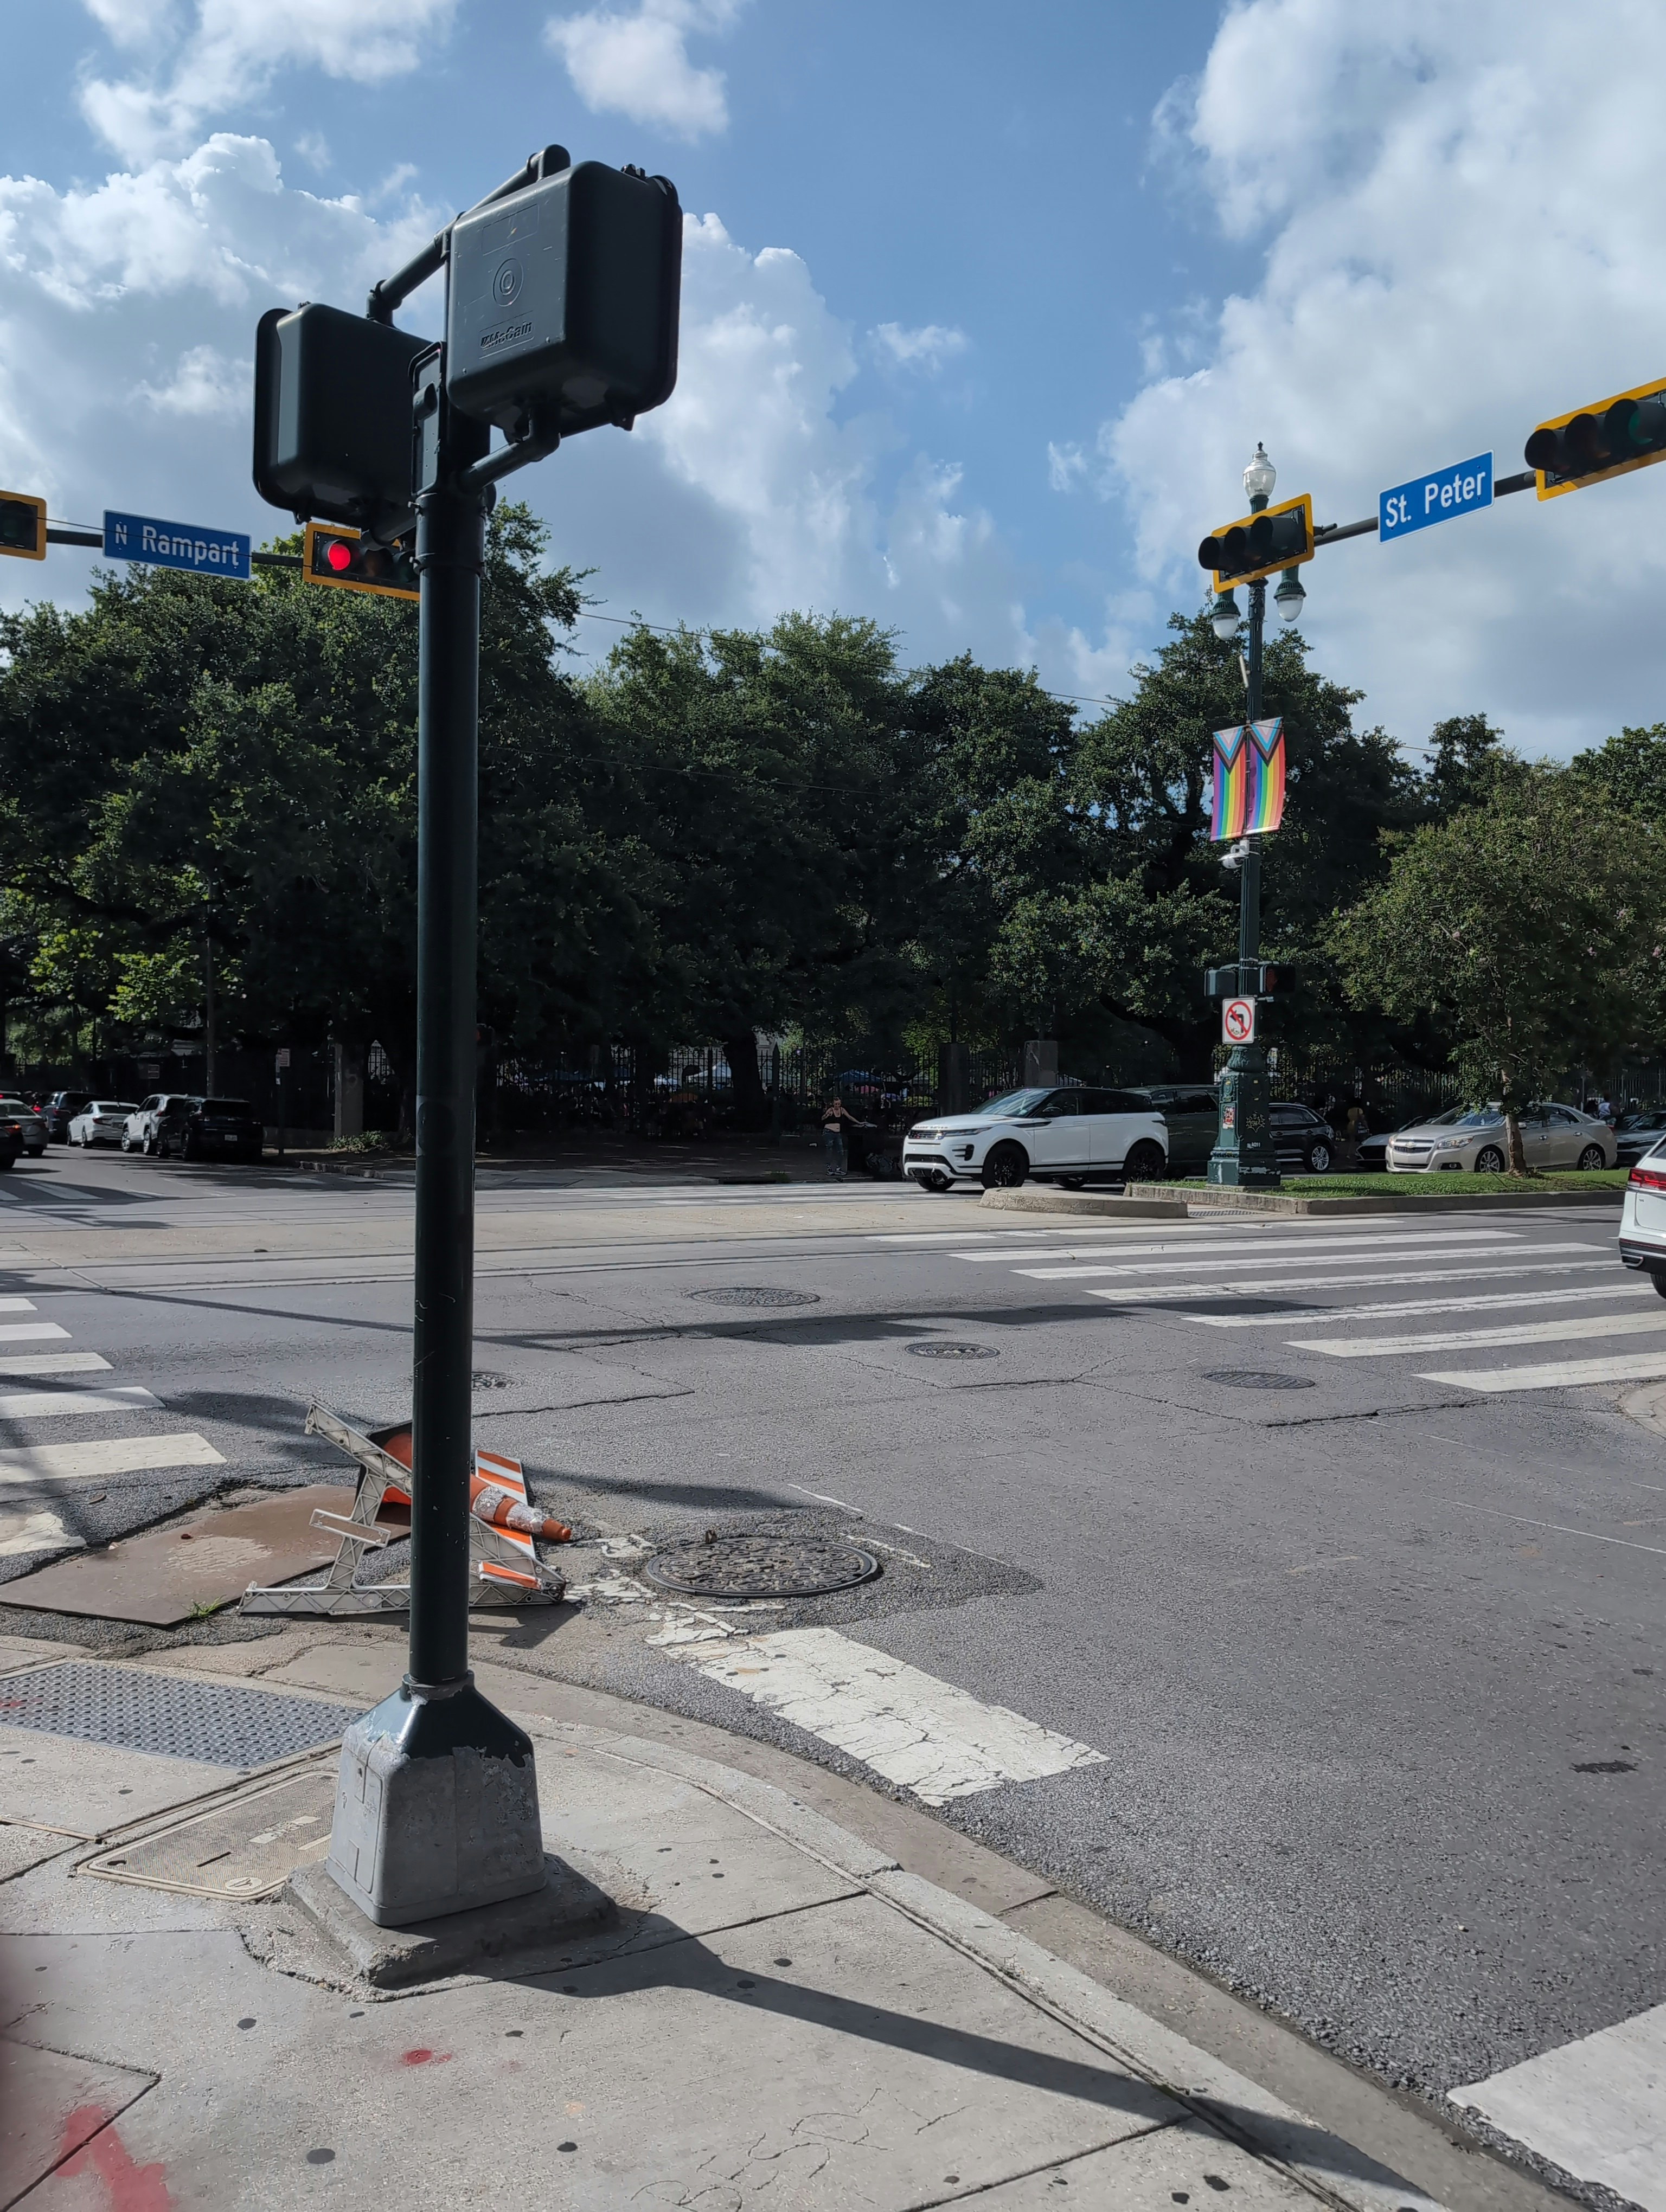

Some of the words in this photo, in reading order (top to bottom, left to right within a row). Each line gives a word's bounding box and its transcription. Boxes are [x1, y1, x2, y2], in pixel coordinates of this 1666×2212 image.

[488, 321, 533, 348] McCain
[1385, 494, 1412, 528] St.
[1425, 472, 1486, 515] Peter
[116, 524, 127, 545] N
[142, 525, 239, 566] Rampart
